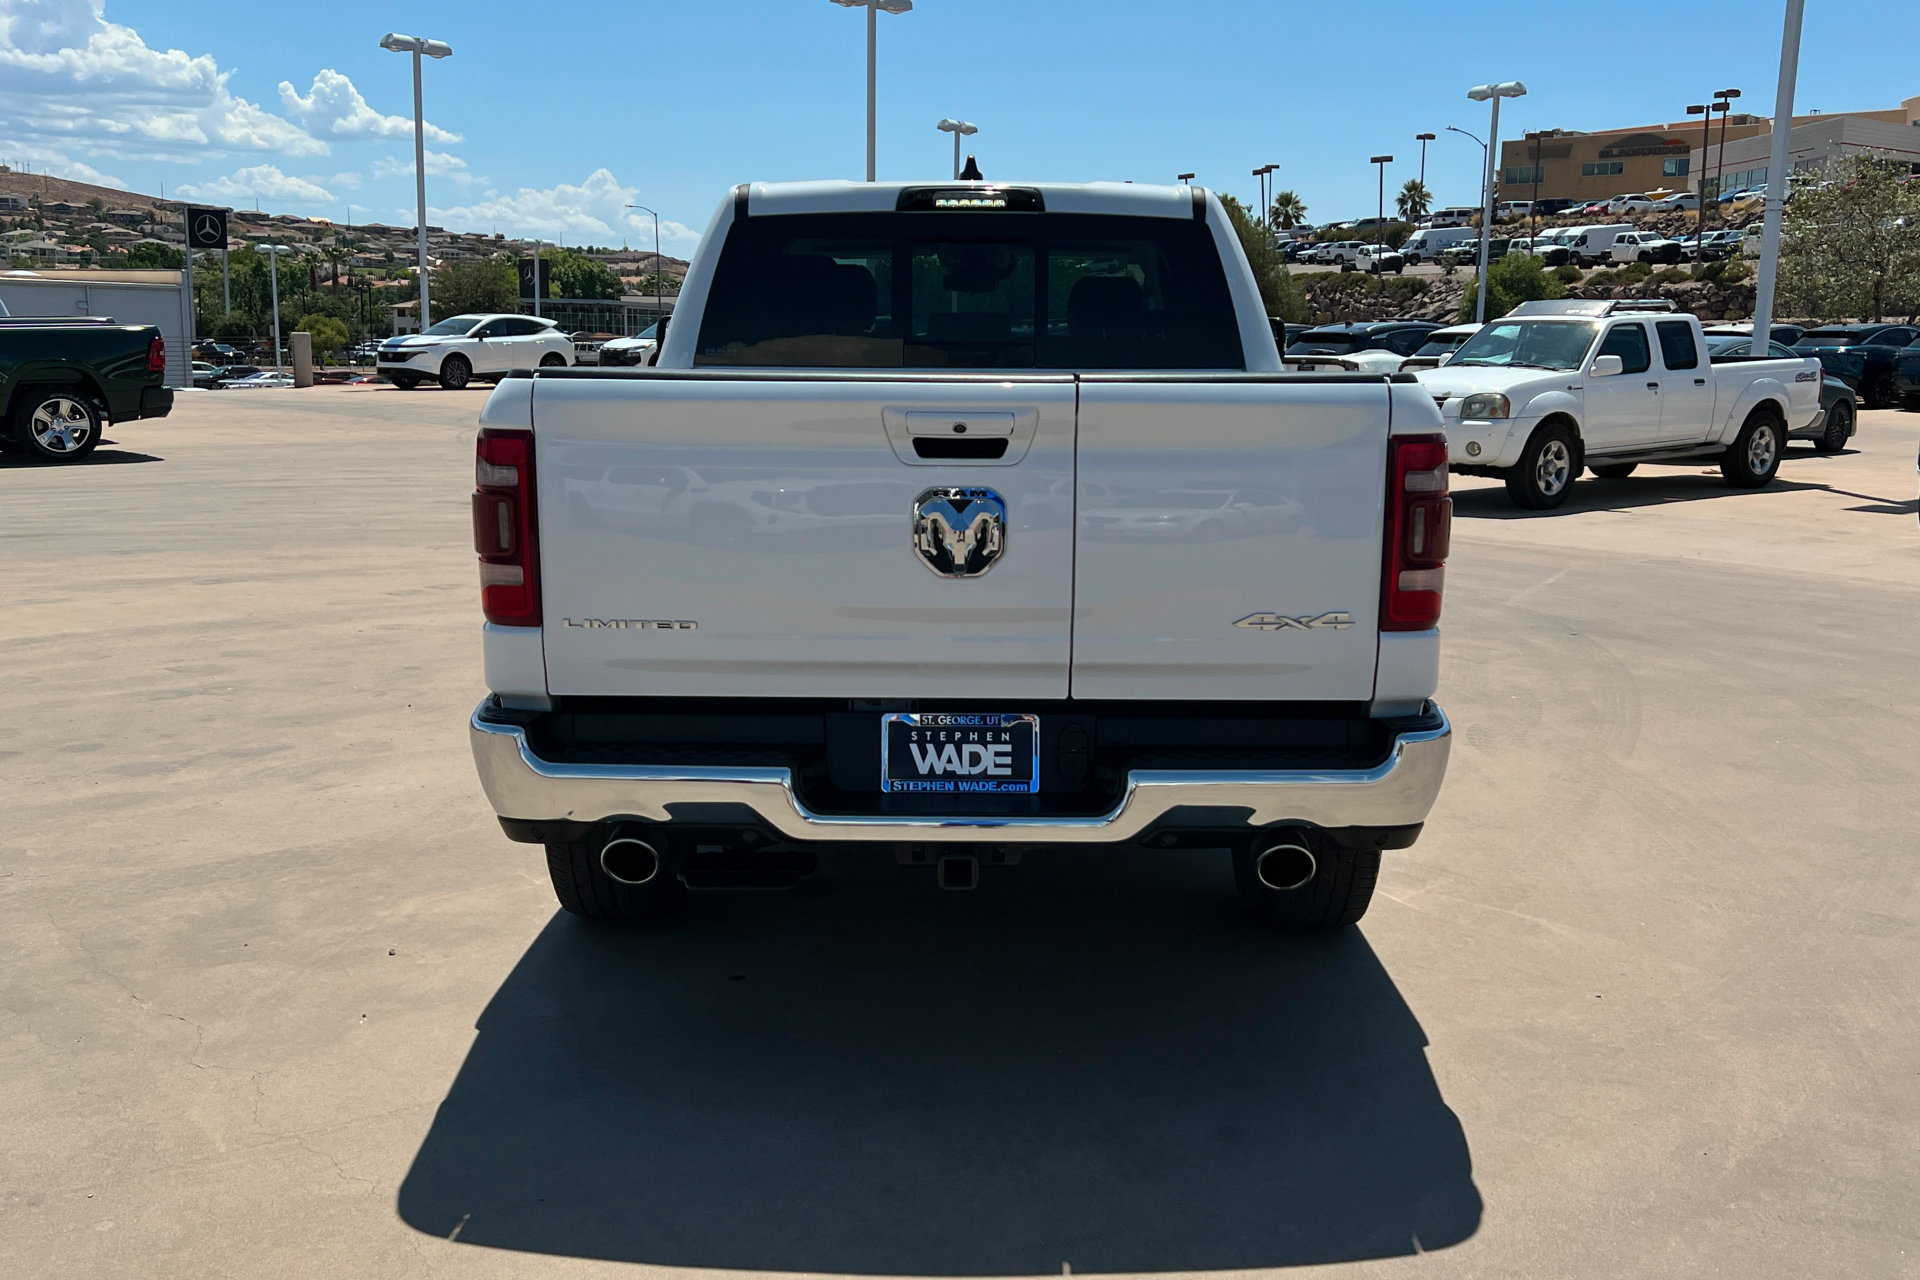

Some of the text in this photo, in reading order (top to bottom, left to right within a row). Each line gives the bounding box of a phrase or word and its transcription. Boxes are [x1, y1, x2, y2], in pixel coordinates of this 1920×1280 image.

[931, 489, 988, 498] RAM
[562, 617, 699, 630] LIMITED
[921, 715, 935, 725] ST.
[986, 715, 1000, 725] UT
[911, 731, 1011, 741] STEPHEN
[909, 743, 1012, 775] WADE
[893, 781, 1028, 791] STEPHEN WADE.com
